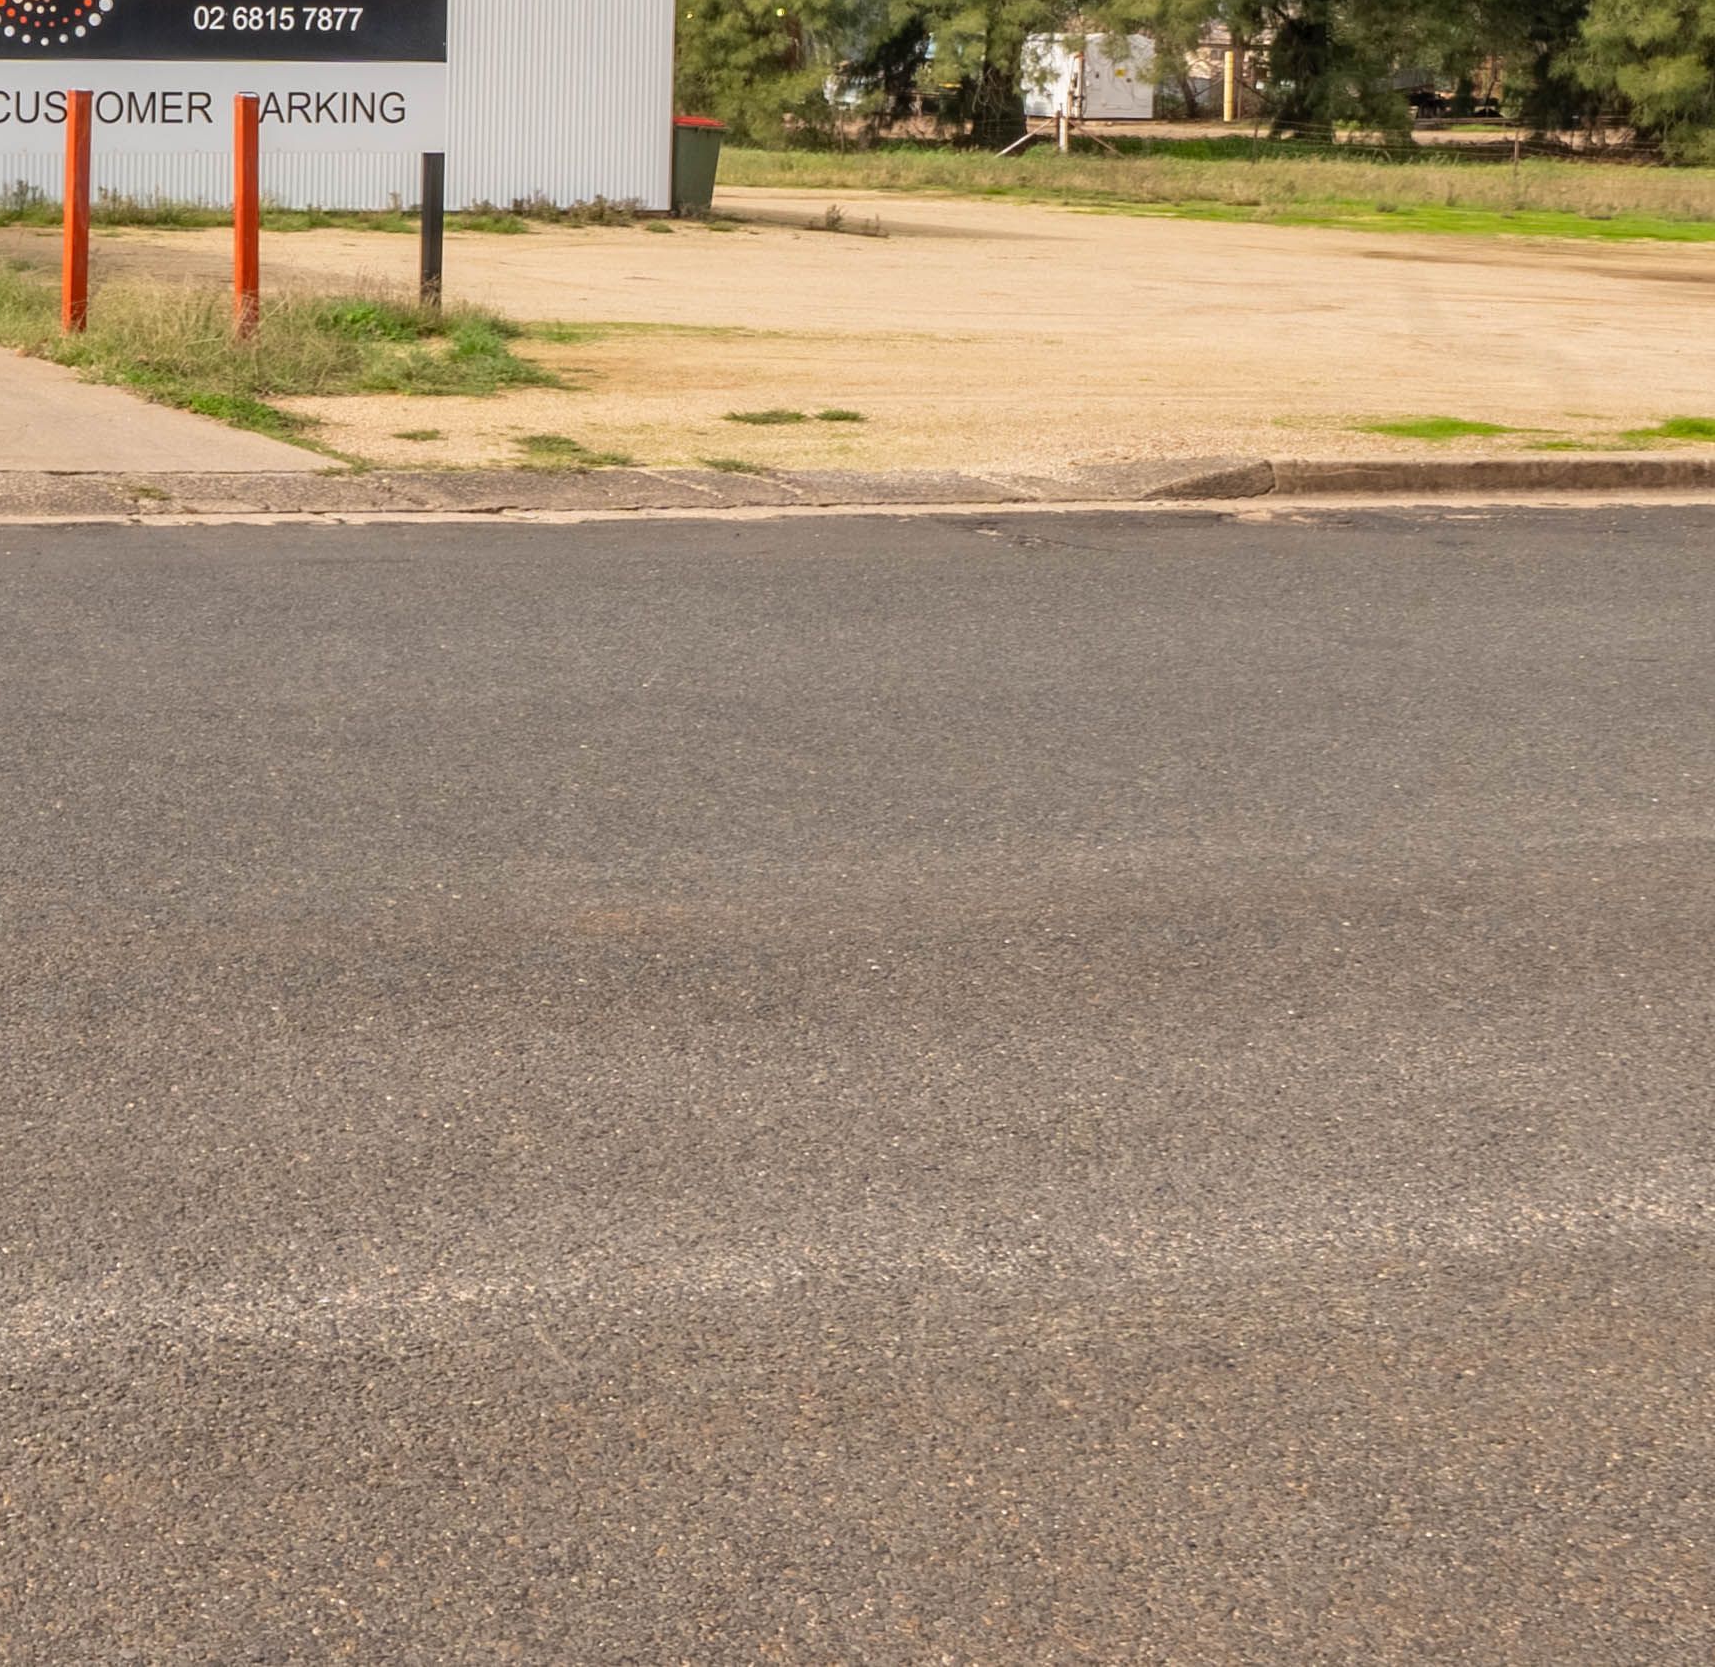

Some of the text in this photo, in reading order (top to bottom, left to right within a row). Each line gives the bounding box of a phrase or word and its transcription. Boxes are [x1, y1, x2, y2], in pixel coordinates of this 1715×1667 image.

[193, 6, 364, 31] 02 6815 7877
[238, 91, 407, 124] ARKING
